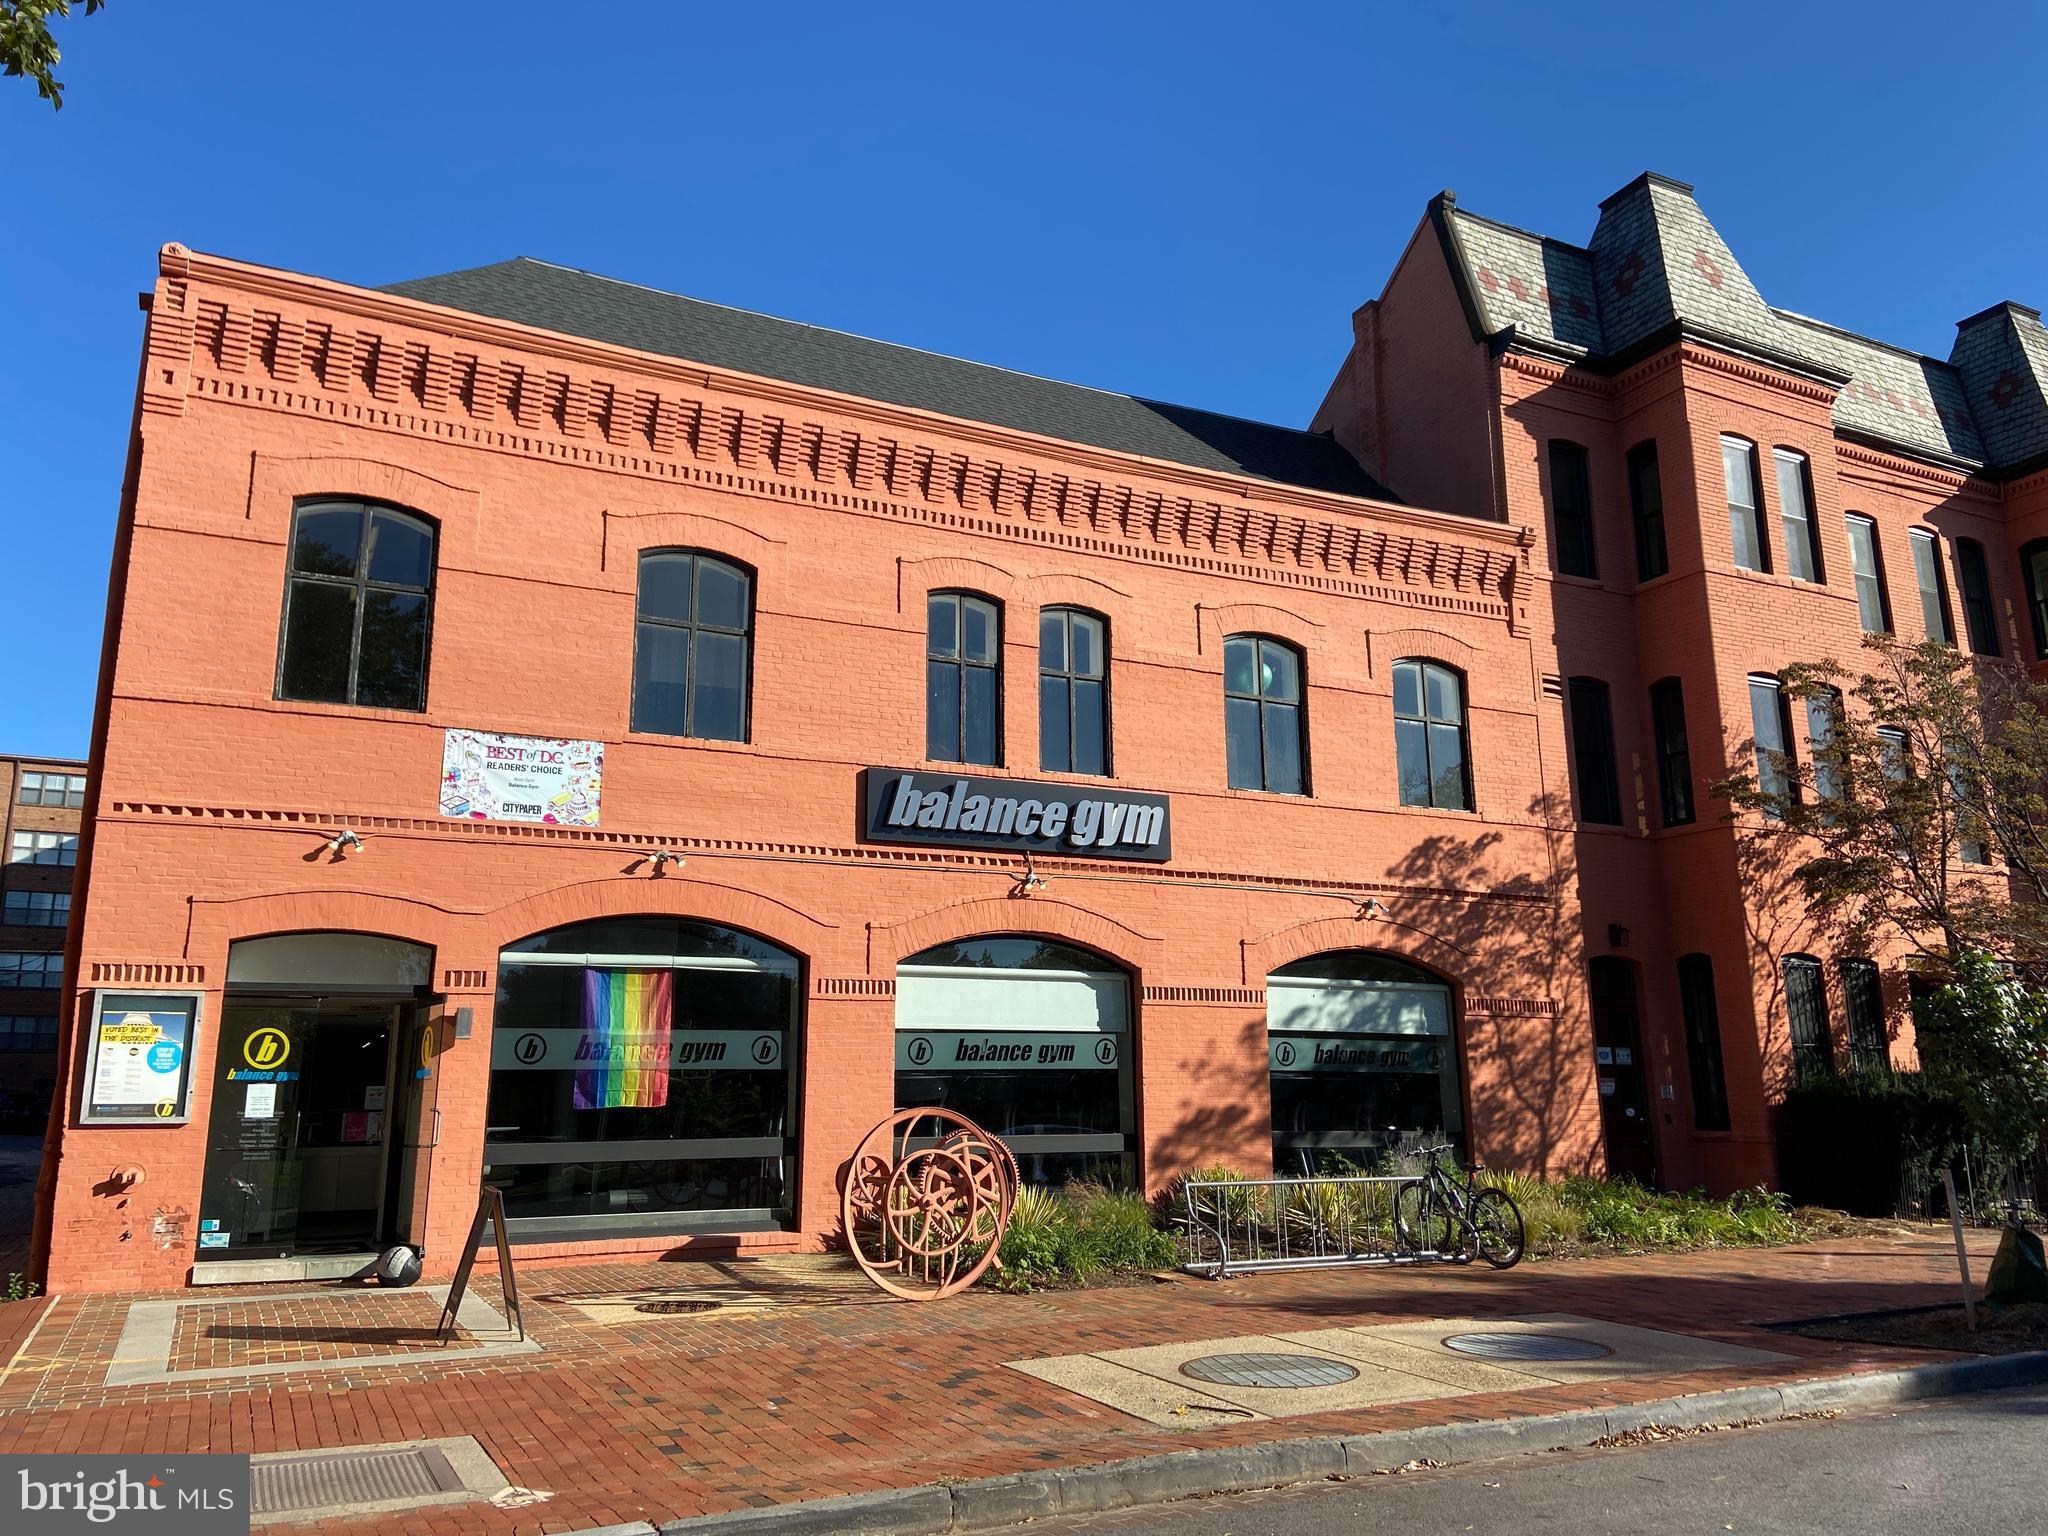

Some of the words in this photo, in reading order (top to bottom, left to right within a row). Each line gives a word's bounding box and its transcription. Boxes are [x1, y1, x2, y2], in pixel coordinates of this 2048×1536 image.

[485, 745, 527, 761] BEST
[526, 750, 537, 760] of
[486, 762, 529, 772] READERS'
[530, 765, 563, 775] CHOICE
[887, 775, 1068, 837] balance
[1070, 799, 1165, 846] gym
[255, 1035, 278, 1062] b
[522, 1038, 537, 1060] b
[678, 1041, 727, 1064] gym
[758, 1040, 772, 1060] b
[915, 1042, 927, 1061] b
[954, 1038, 1033, 1062] balance
[1037, 1044, 1076, 1064] gym
[1101, 1043, 1112, 1060] b
[1281, 1046, 1290, 1062] b
[1314, 1043, 1376, 1066] balance
[1379, 1048, 1409, 1068] gym
[226, 1068, 275, 1080] balance
[275, 1071, 300, 1081] gym
